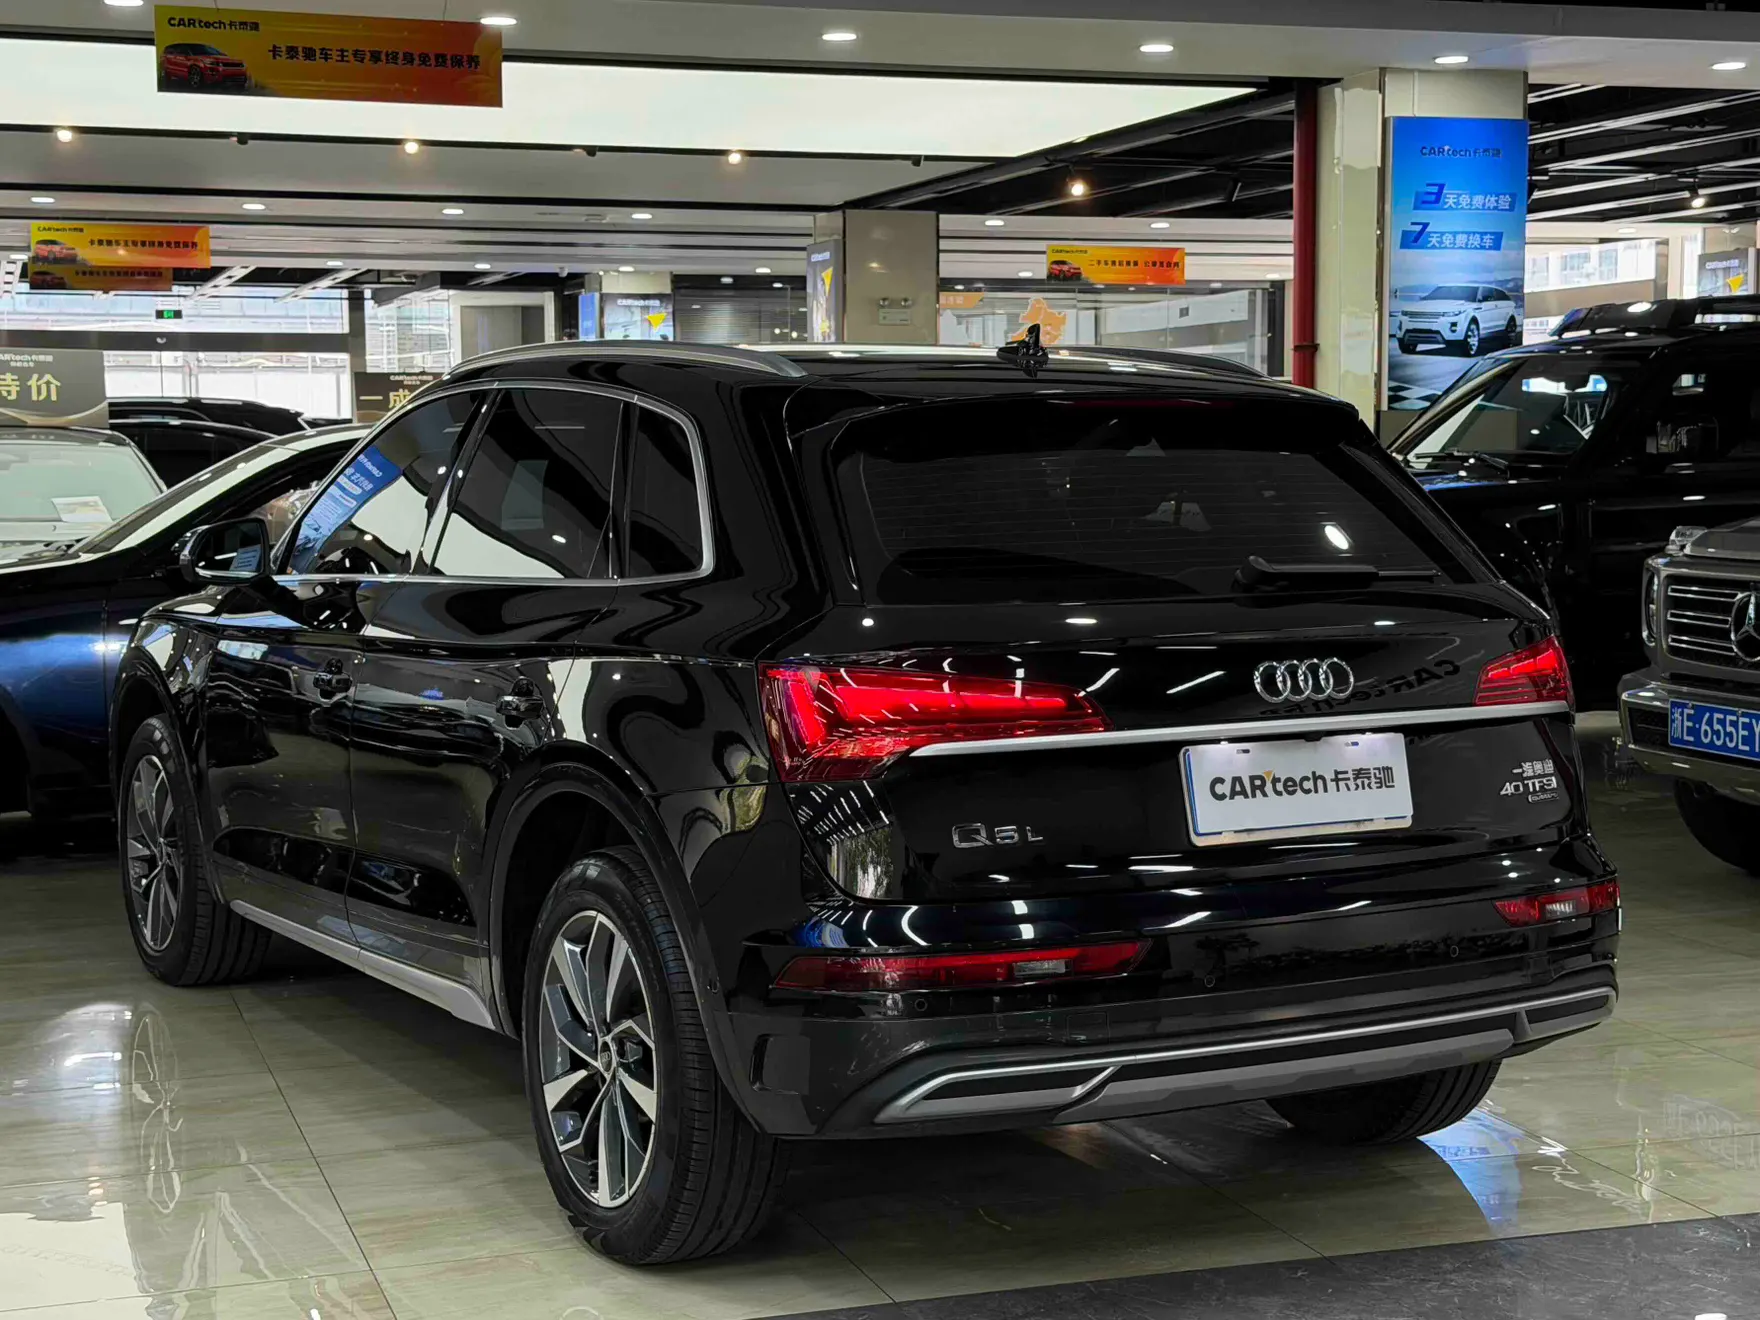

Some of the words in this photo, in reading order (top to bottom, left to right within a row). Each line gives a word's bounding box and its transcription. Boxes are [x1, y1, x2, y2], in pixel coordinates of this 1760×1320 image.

[268, 43, 481, 70] 卡泰驰车主专享终身免费保养
[1500, 781, 1524, 796] 40
[1524, 776, 1557, 792] TFSI
